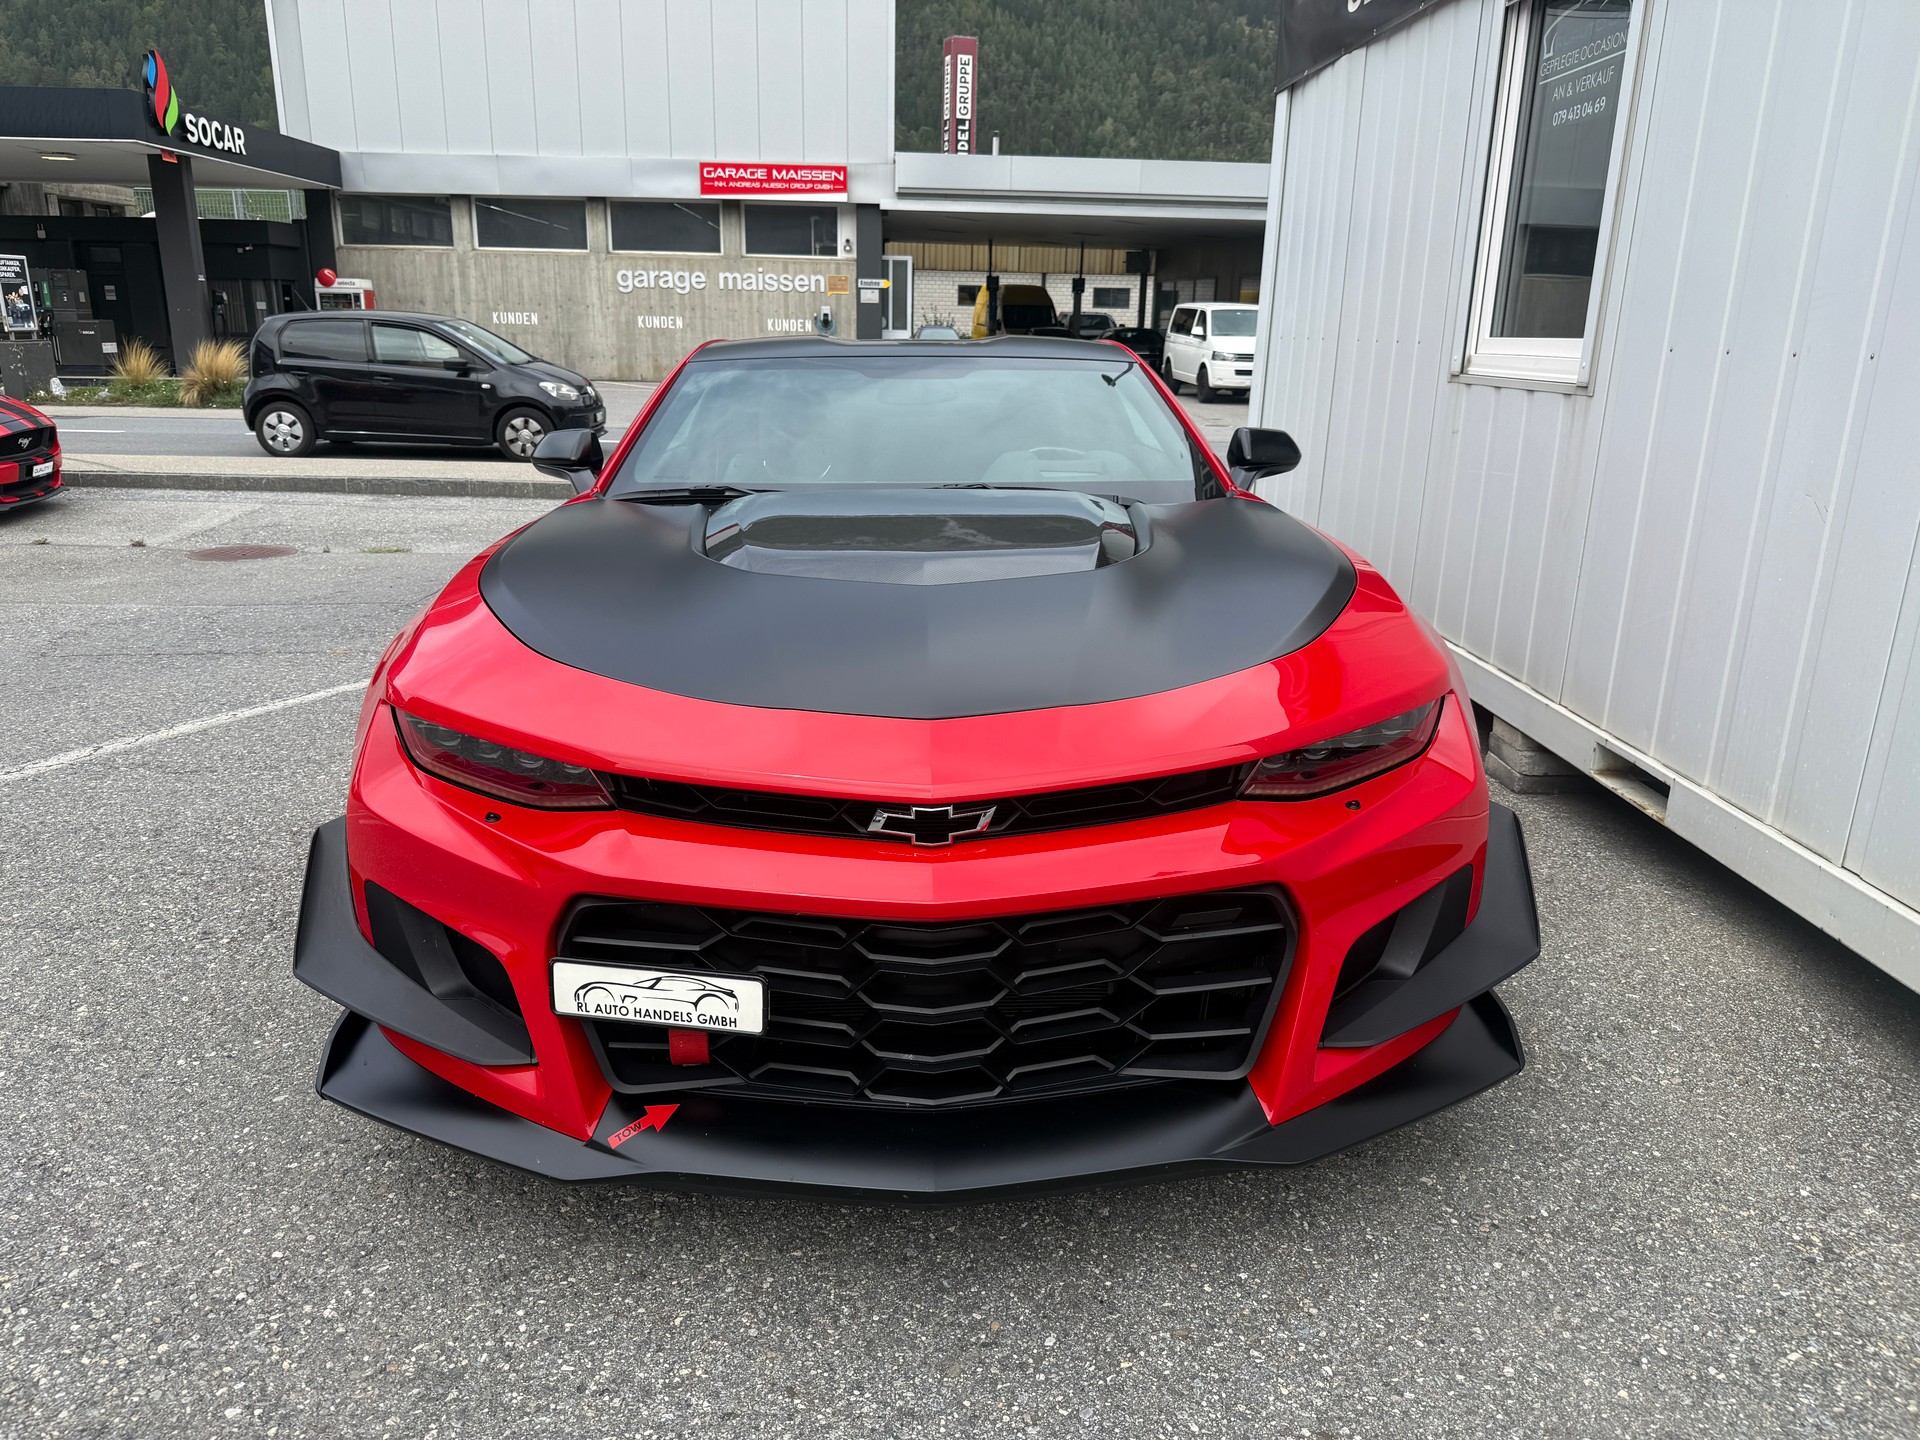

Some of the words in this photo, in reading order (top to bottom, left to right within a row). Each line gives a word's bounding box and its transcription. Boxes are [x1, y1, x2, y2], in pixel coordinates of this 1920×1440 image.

[1540, 48, 1580, 77] GEPFLEGTE
[1580, 29, 1628, 61] OCCASION
[959, 57, 971, 116] GRUPPE
[1552, 83, 1565, 102] AN
[1566, 82, 1573, 97] &
[1575, 65, 1615, 93] VERKAUF
[1552, 109, 1567, 127] 079
[1567, 104, 1581, 122] 413
[1581, 100, 1593, 117] 04
[1594, 96, 1606, 114] 69
[185, 113, 247, 155] SOCAR
[703, 167, 768, 179] GARAGE
[772, 169, 844, 181] MAISSEN
[616, 269, 707, 295] garage
[718, 267, 825, 293] maissen
[492, 311, 538, 325] KUNDEN
[637, 315, 683, 329] KUNDEN
[767, 318, 812, 332] KUNDEN
[576, 1001, 590, 1014] RL
[594, 1003, 630, 1017] AUTO
[633, 1007, 693, 1023] HANDELS
[697, 1014, 738, 1028] GMBH
[614, 1121, 643, 1143] TOW
